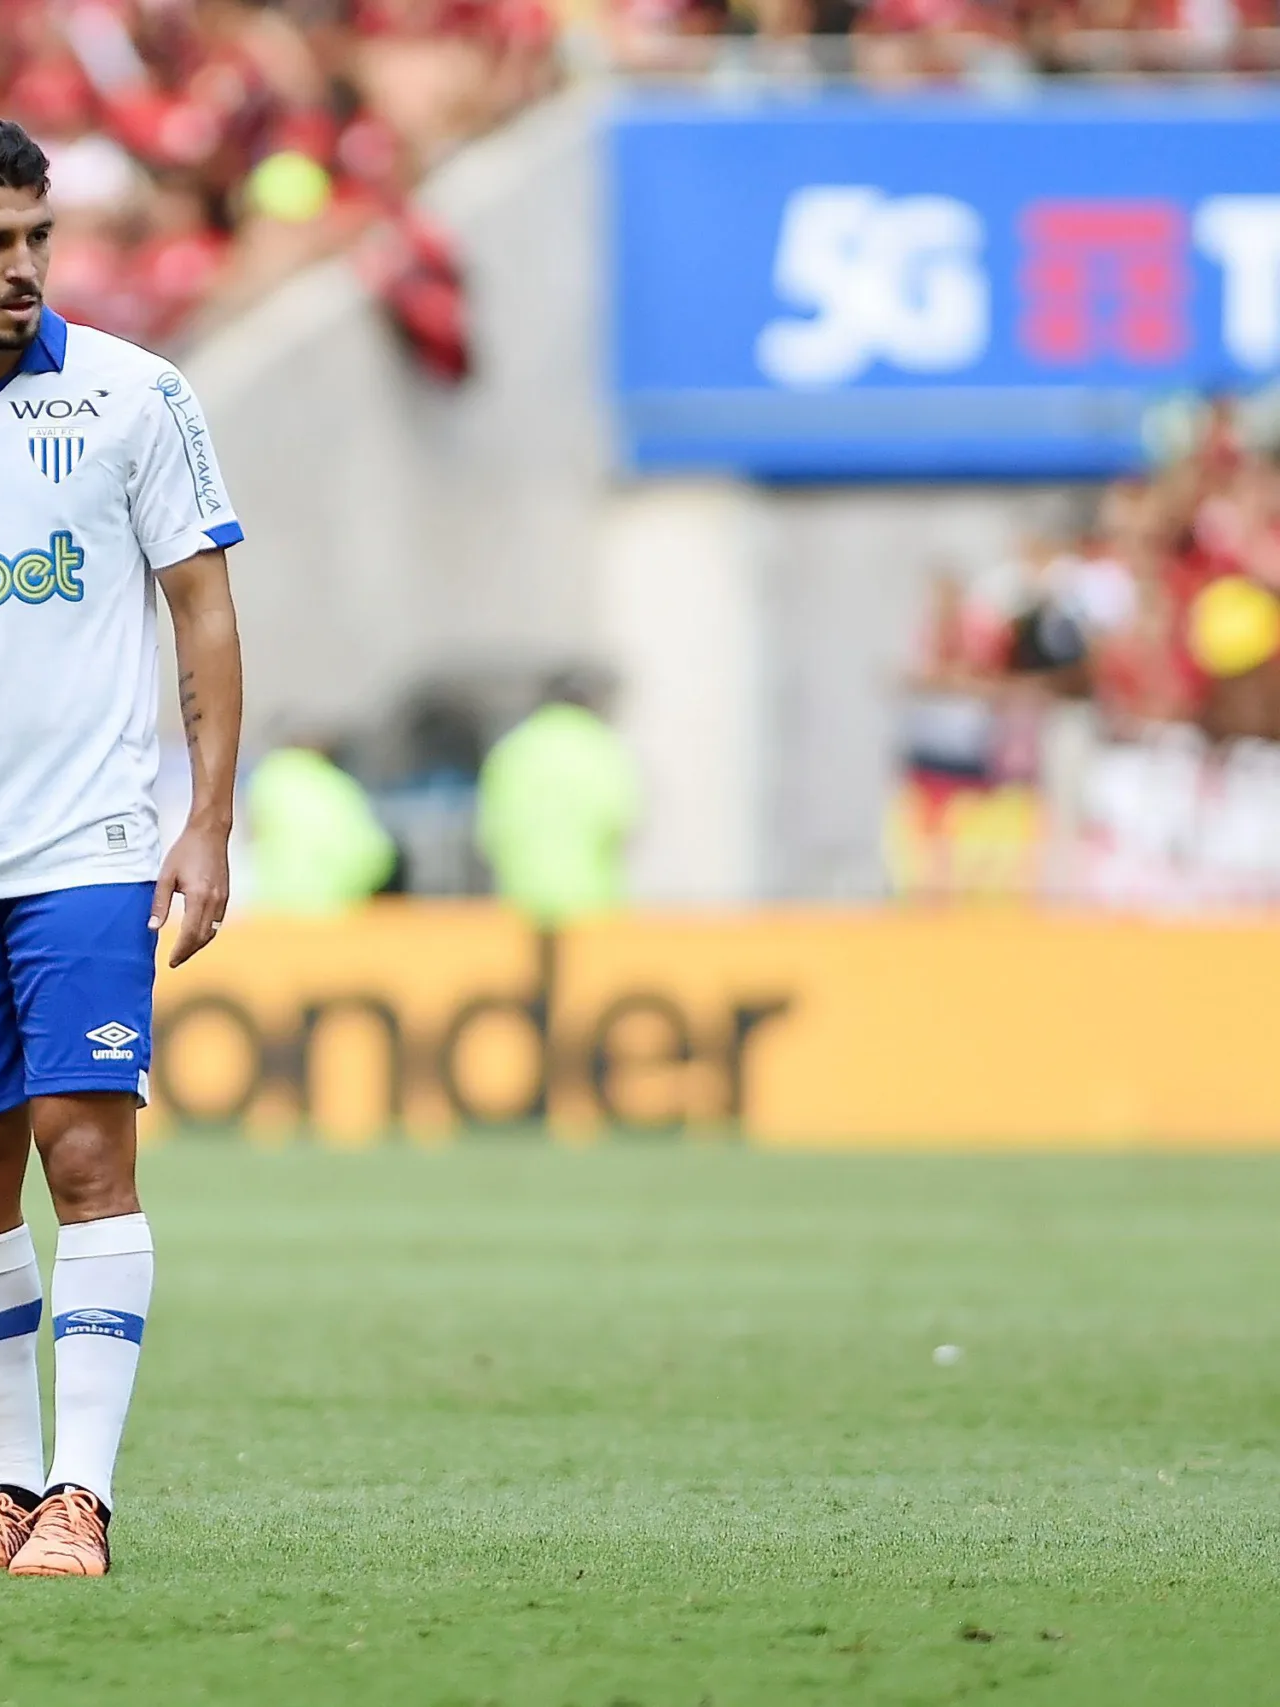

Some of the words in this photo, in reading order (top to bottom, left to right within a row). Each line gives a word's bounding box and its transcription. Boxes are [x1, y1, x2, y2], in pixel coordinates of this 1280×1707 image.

[755, 185, 990, 385] 5G
[7, 398, 101, 420] WOA
[152, 930, 794, 1130] onder
[92, 1047, 135, 1061] umbro
[65, 1324, 124, 1338] umbro
